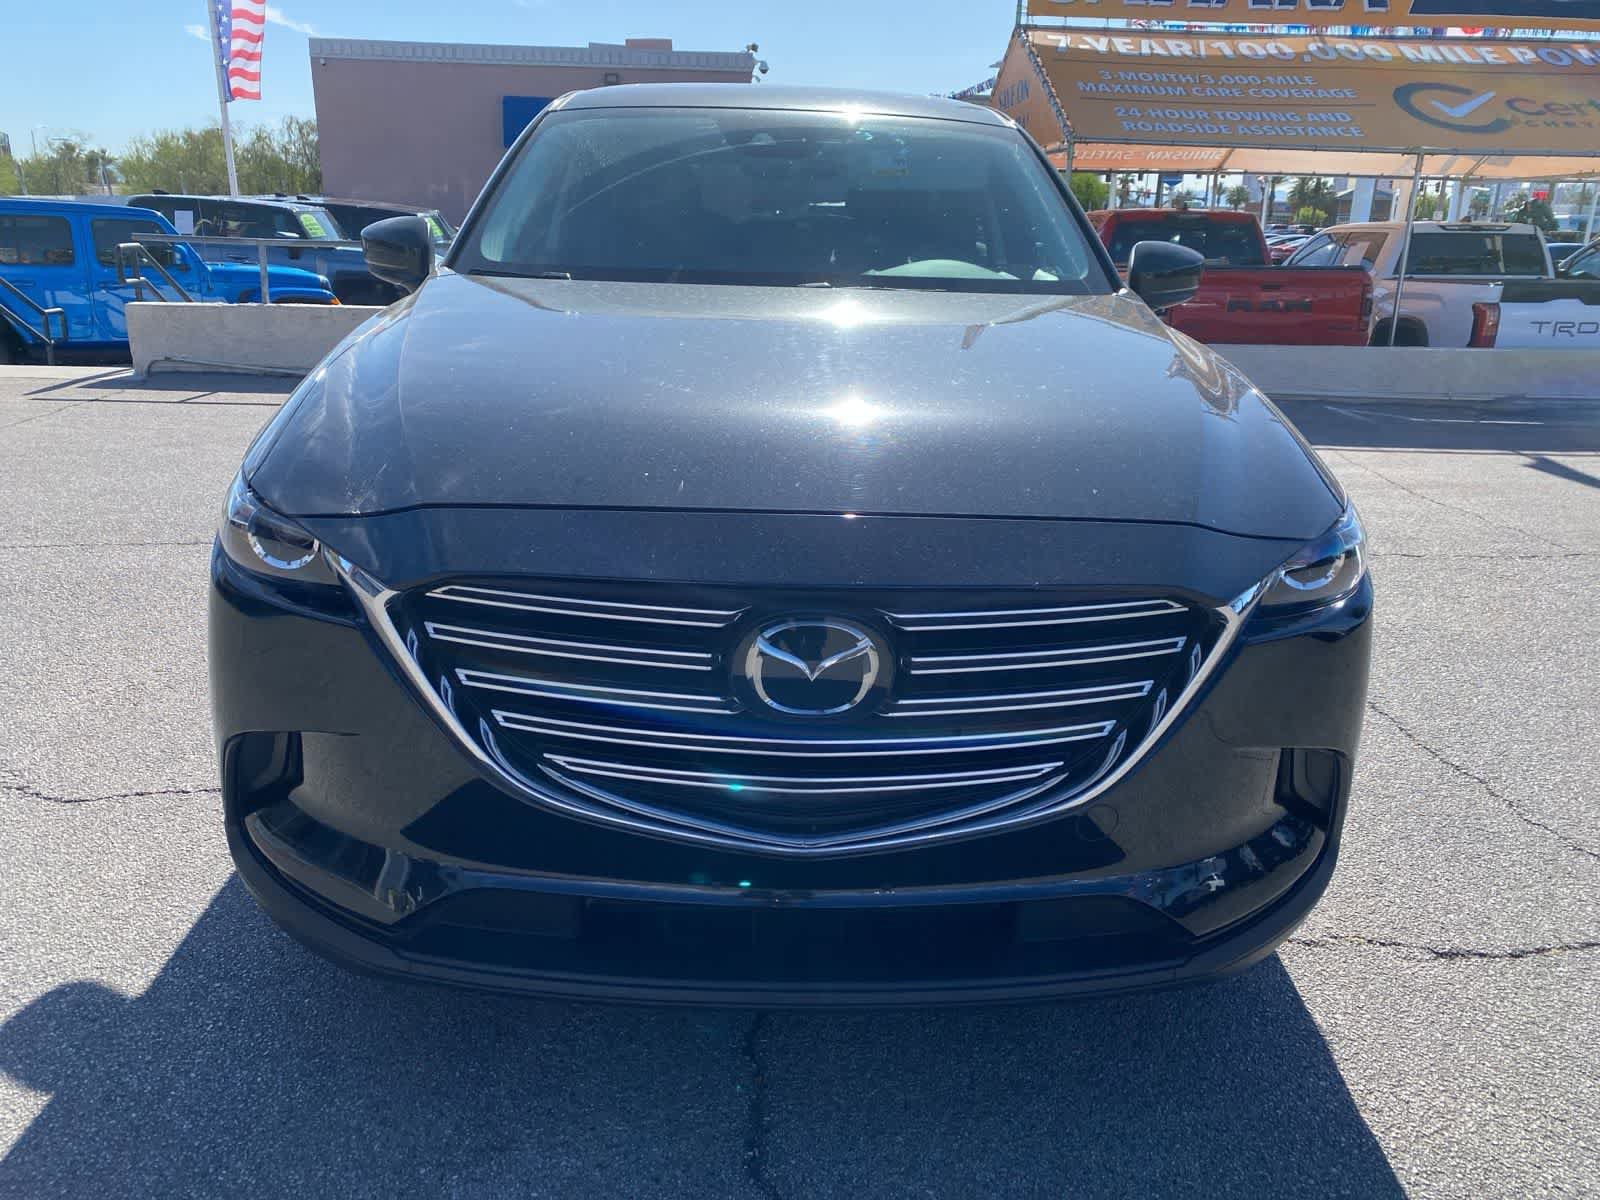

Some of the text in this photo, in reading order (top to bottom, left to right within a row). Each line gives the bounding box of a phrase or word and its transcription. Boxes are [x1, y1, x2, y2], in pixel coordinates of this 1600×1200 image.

[1398, 44, 1510, 65] MILE
[1076, 80, 1358, 99] MAXIMUM CARE COVERAGE
[1214, 110, 1300, 123] TOWING
[1306, 112, 1351, 123] AND
[1121, 120, 1365, 137] ROADSIDE ASSISTANCE
[1226, 296, 1313, 312] RAM
